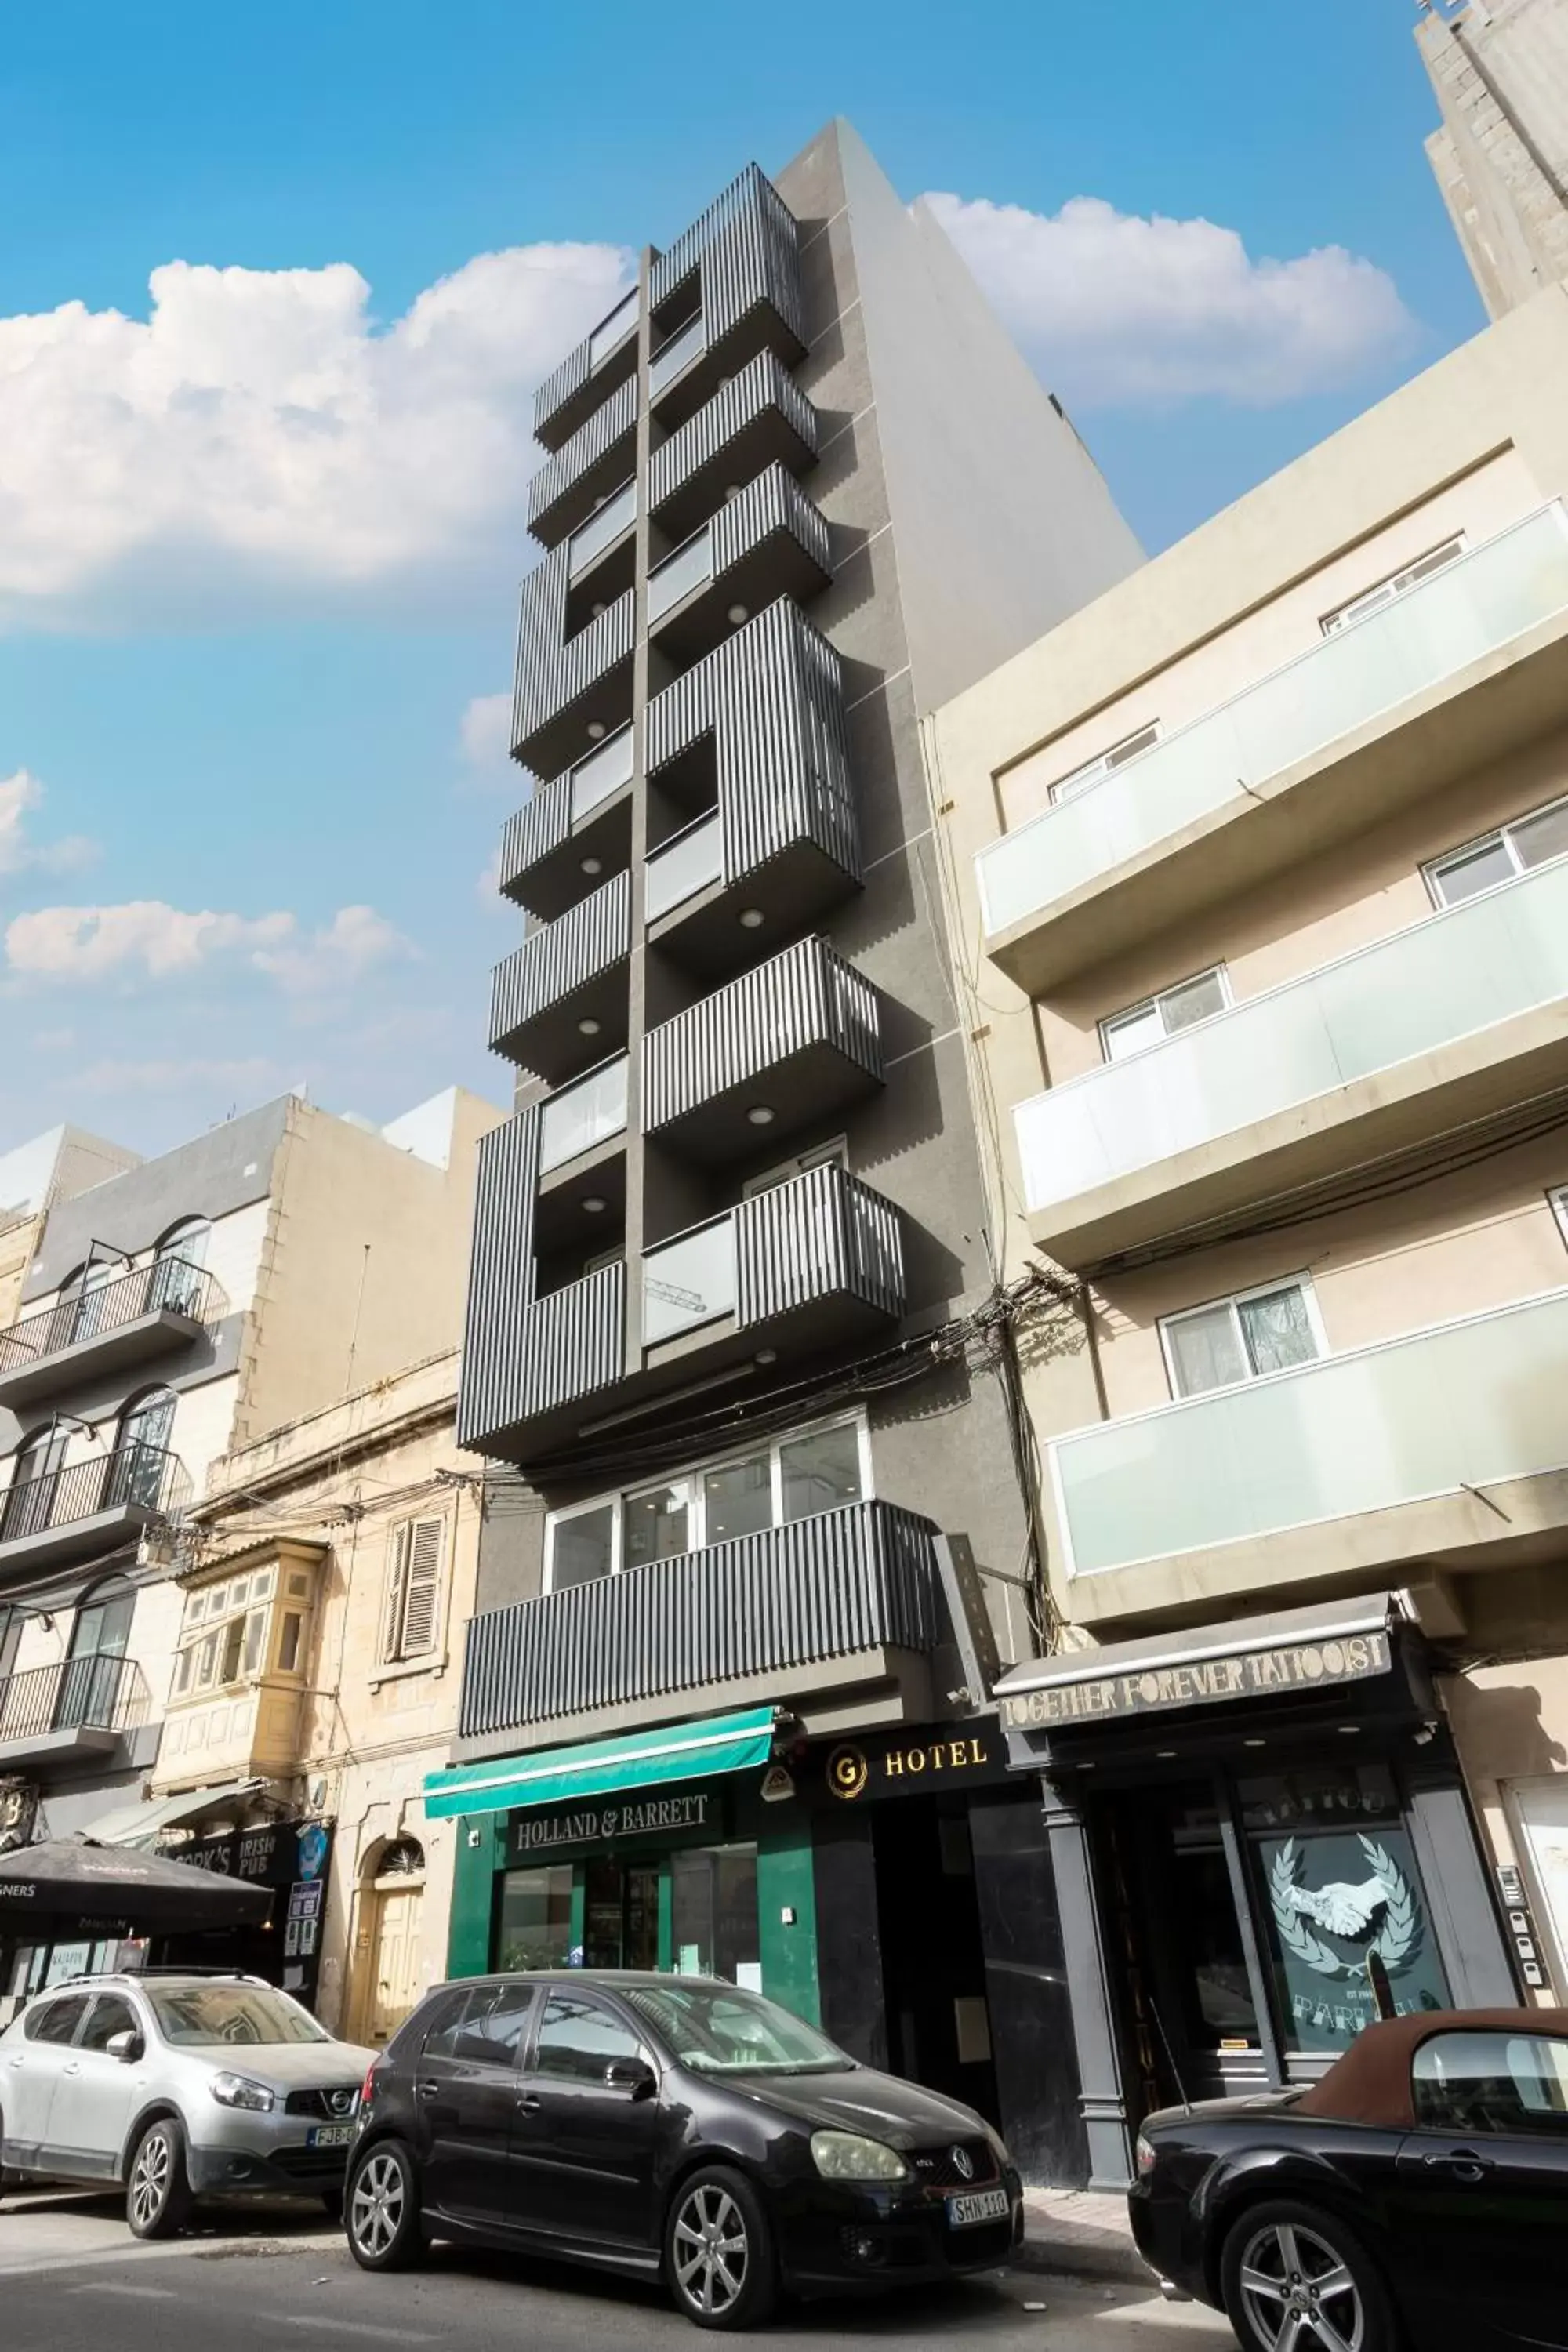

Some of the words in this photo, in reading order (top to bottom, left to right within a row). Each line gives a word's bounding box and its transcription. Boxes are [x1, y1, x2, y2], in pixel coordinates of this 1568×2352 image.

[1001, 1680, 1117, 1726] TOGETHER
[1120, 1660, 1245, 1707] FOREVER
[1247, 1635, 1383, 1686] TATTOOIST
[885, 1739, 988, 1776] HOTEL
[517, 1812, 597, 1850] HOLLAND
[601, 1809, 618, 1838] &
[622, 1794, 708, 1830] BARRETT
[239, 1836, 276, 1859] IRISH
[239, 1857, 267, 1877] PUB
[956, 2195, 982, 2222] SHN
